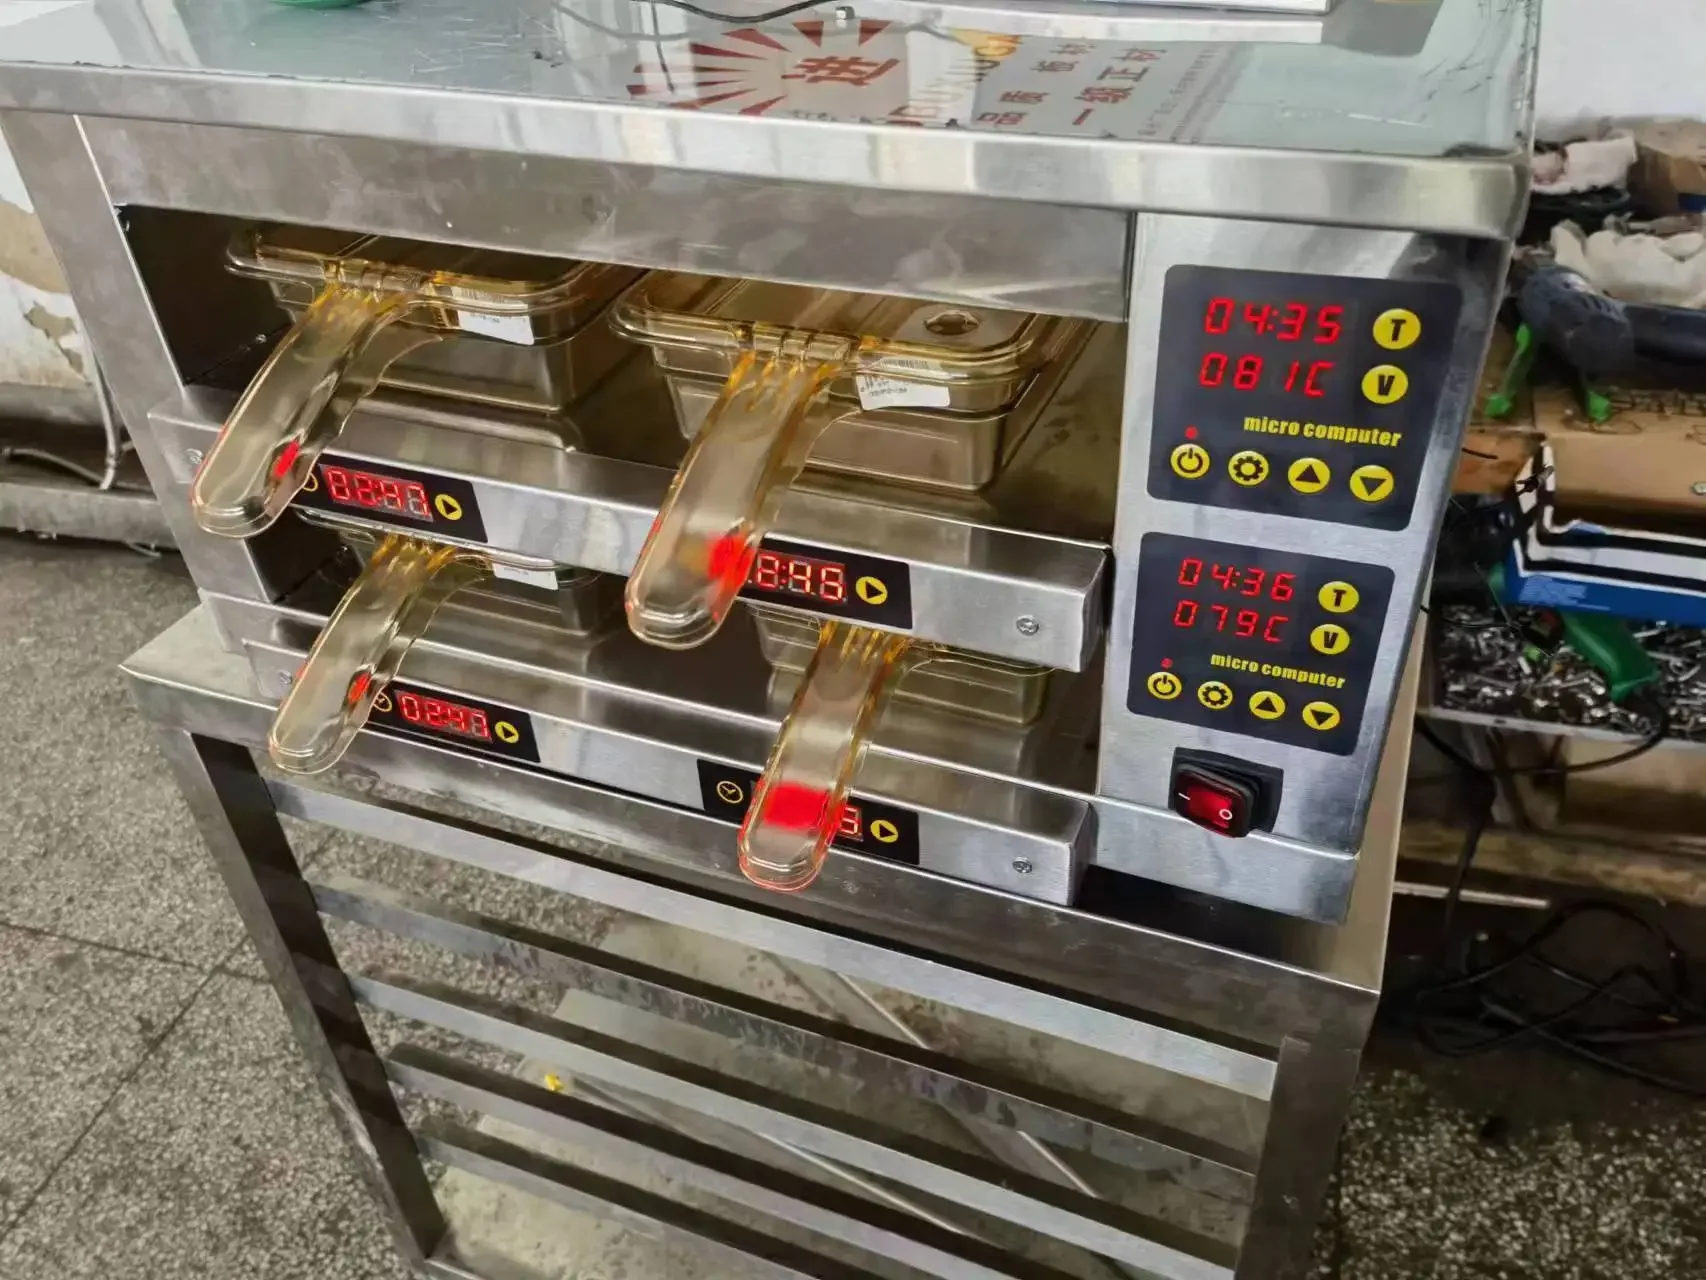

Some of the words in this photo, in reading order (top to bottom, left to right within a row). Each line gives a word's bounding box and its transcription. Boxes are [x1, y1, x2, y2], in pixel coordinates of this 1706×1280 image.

[1204, 297, 1344, 344] 04:35
[1390, 317, 1407, 342] T
[1199, 352, 1336, 397] 081C
[1376, 373, 1396, 397] V
[1243, 416, 1300, 437] micro
[1302, 422, 1402, 448] computer
[757, 554, 844, 601] 2:45
[1178, 558, 1297, 602] 04:36
[1174, 599, 1290, 643] 079C
[1322, 631, 1341, 650] V
[1211, 653, 1258, 674] micro
[1260, 663, 1346, 690] computer
